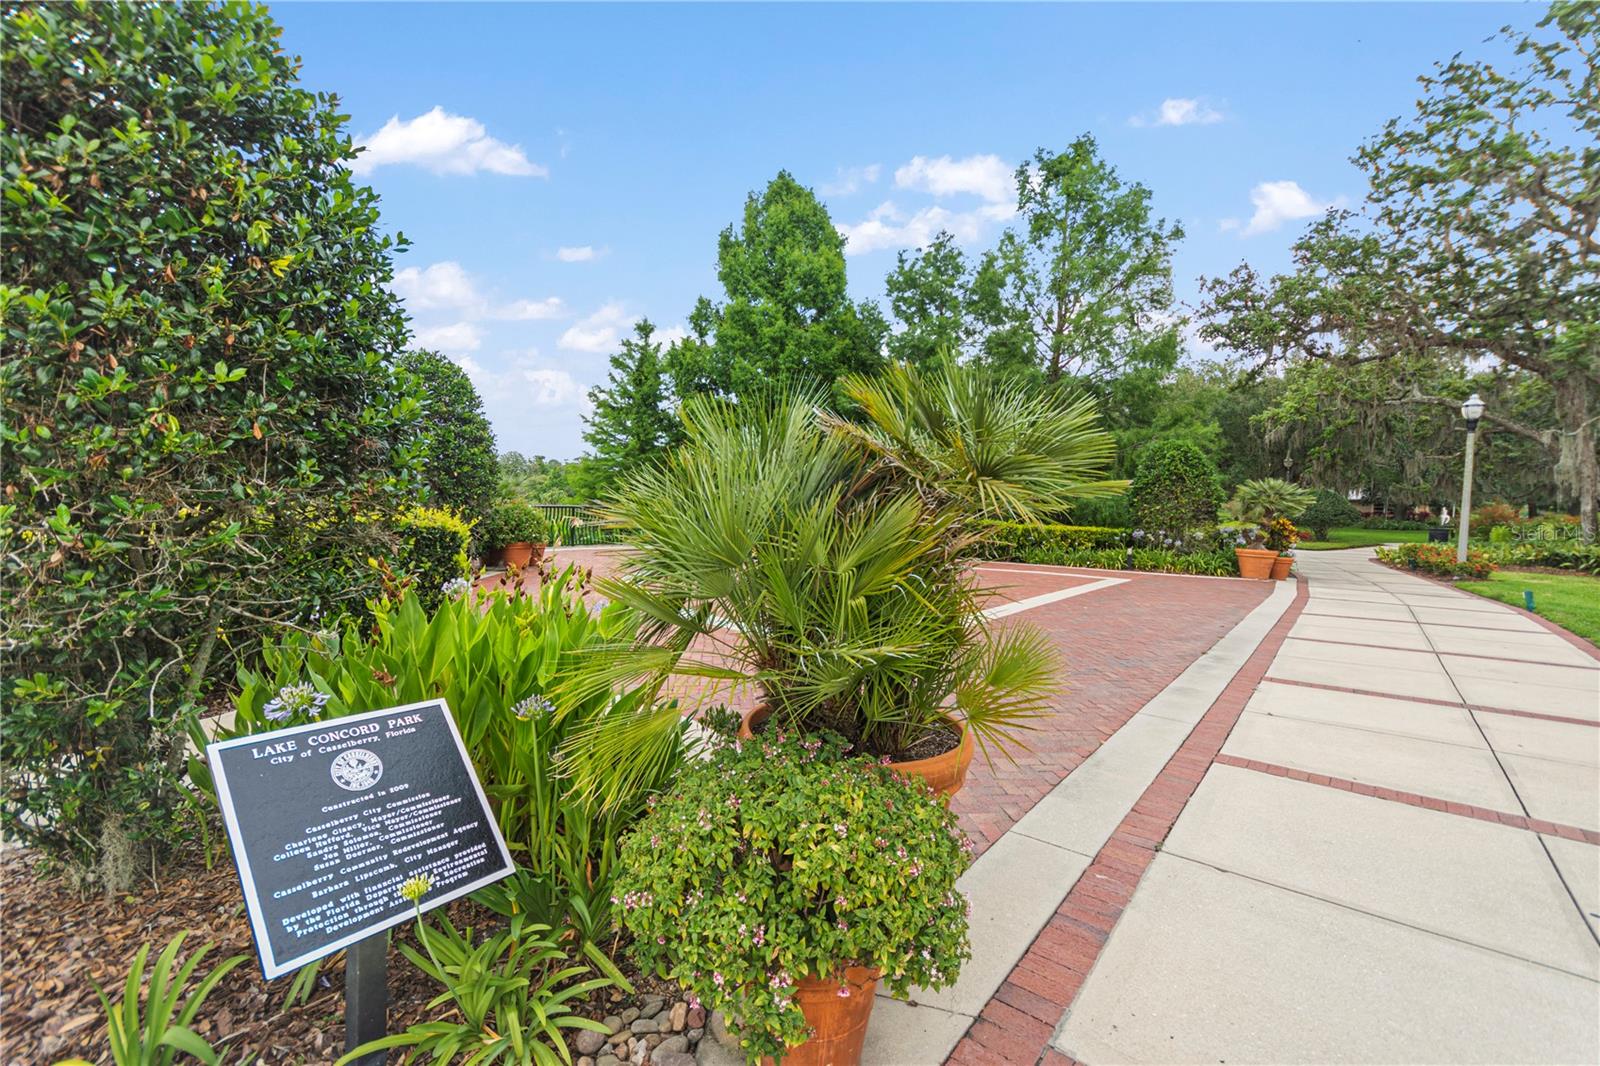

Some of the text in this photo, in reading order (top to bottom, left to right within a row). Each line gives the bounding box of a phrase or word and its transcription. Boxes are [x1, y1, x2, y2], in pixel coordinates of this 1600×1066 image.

[252, 714, 423, 759] LAKE CONCORD PARK
[270, 755, 294, 764] City
[300, 749, 311, 757] of
[385, 727, 416, 738] Florida
[285, 833, 328, 850] Charlene
[370, 795, 450, 823] Mayor/Commissioner
[306, 792, 430, 834] Casselberry City Commission
[321, 793, 374, 812] Constructed
[389, 784, 409, 793] 2009
[273, 846, 311, 861] Colleen
[362, 823, 381, 832] Vice
[384, 798, 461, 826] Mayor/Commissioner
[307, 844, 339, 858] Sandra
[388, 810, 442, 831] Commissioner
[314, 859, 340, 871] Susan
[390, 823, 444, 844] Commissioner
[323, 852, 339, 860] Jon
[378, 820, 432, 841] Commissioner
[273, 821, 478, 898] Casselberry Community Redevelopment Agency
[282, 901, 334, 926] Developed
[340, 892, 360, 903] with
[364, 874, 403, 894] financial
[409, 857, 450, 876] assistance
[454, 842, 486, 859] provided
[312, 880, 349, 898] Barbara
[404, 853, 422, 863] City
[426, 840, 458, 855] Manager
[286, 924, 299, 933] by
[305, 915, 321, 925] the
[326, 900, 360, 917] Florida
[433, 849, 488, 874] Environmental
[296, 912, 349, 938] Protection
[354, 896, 389, 913] through
[443, 858, 485, 877] Recreation
[326, 906, 384, 934] Development
[435, 871, 468, 888] Program
